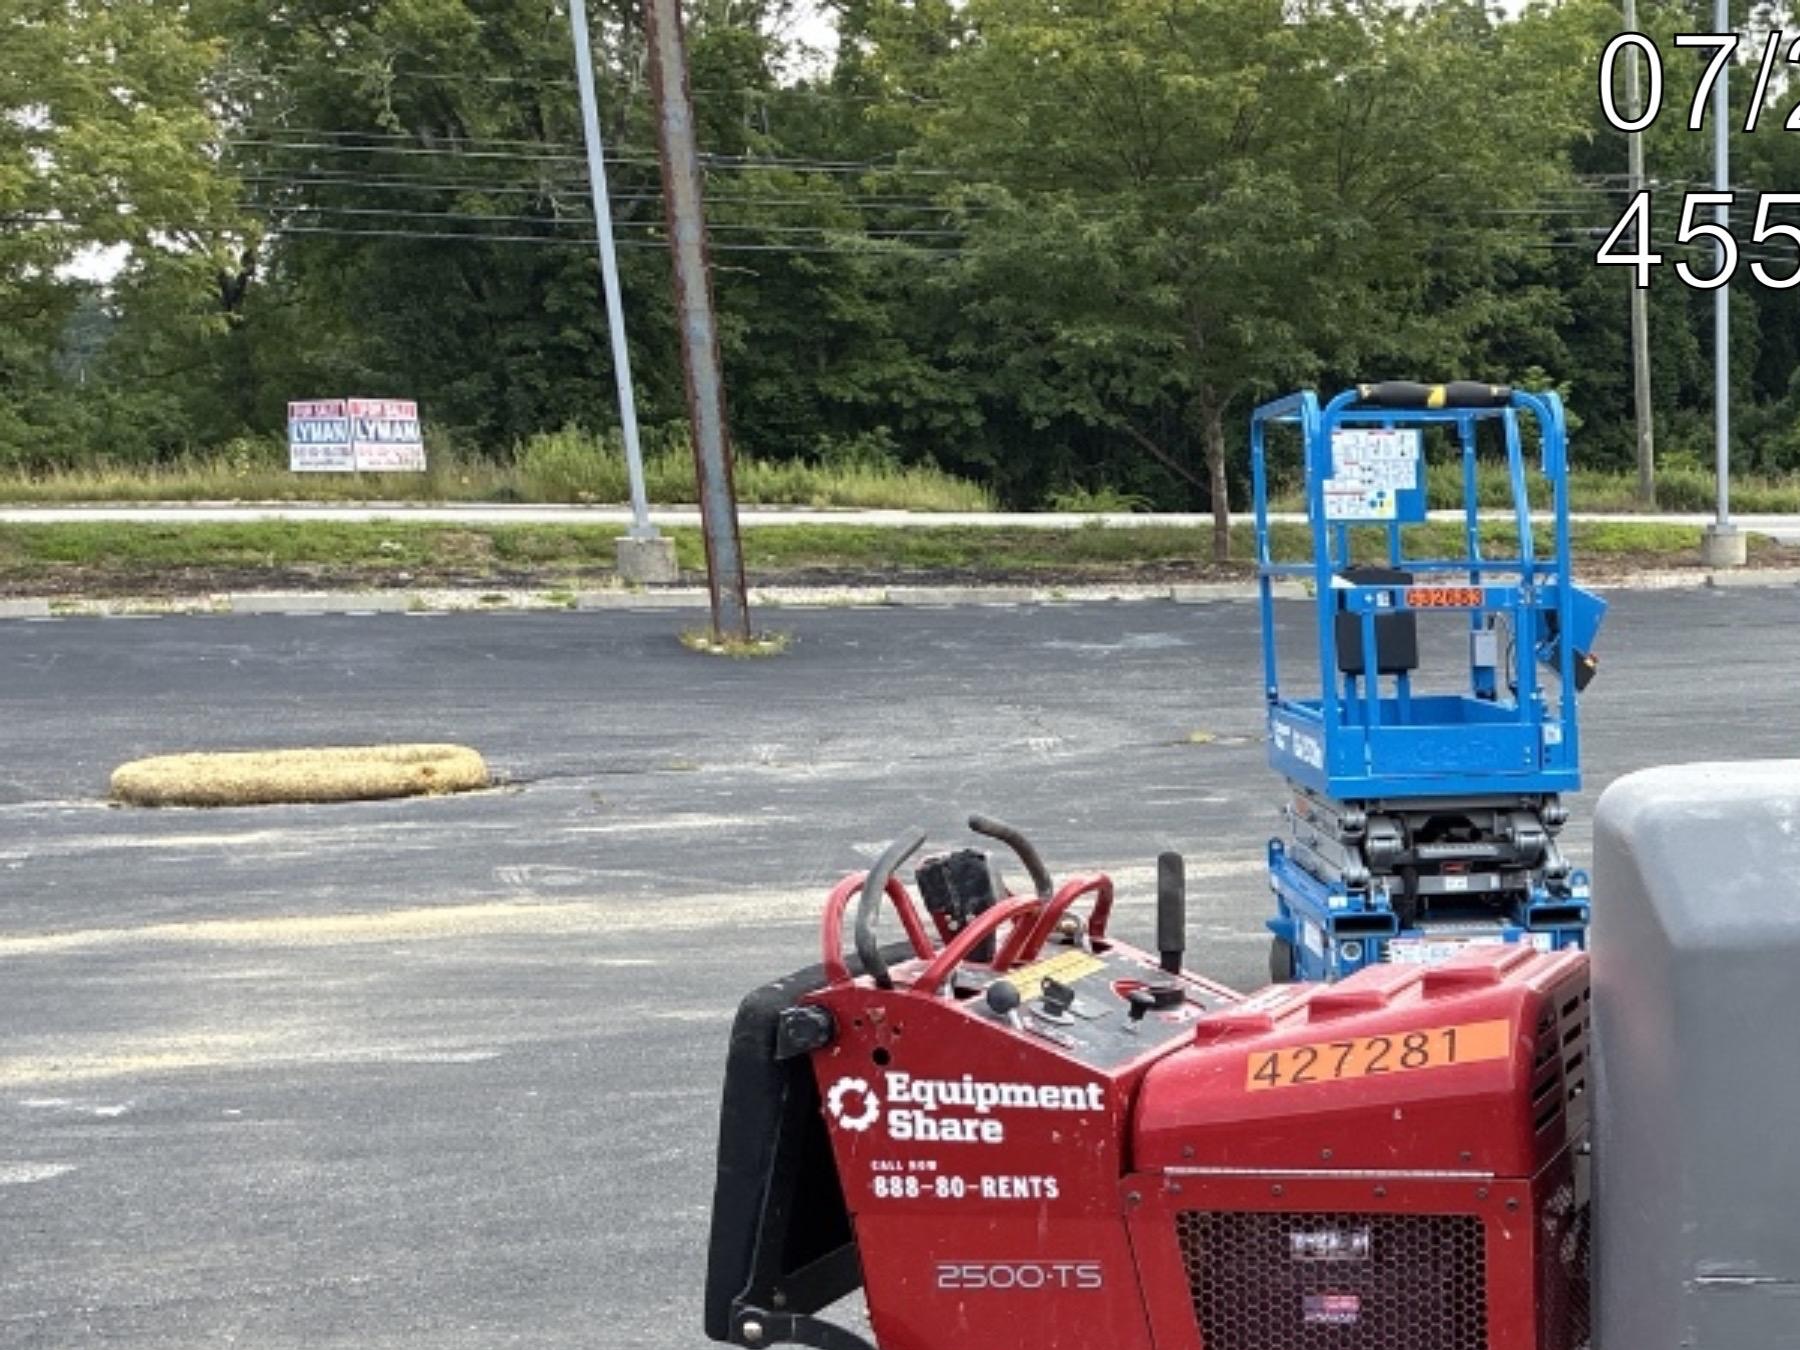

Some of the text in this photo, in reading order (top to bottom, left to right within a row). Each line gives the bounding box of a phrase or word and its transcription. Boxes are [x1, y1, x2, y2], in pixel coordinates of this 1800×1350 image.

[1252, 1028, 1460, 1087] 427281
[885, 1072, 1105, 1111] Equipment
[887, 1109, 1005, 1144] Share
[871, 1160, 937, 1171] CALL NOW
[872, 1175, 1060, 1199] 888-80-RENTS
